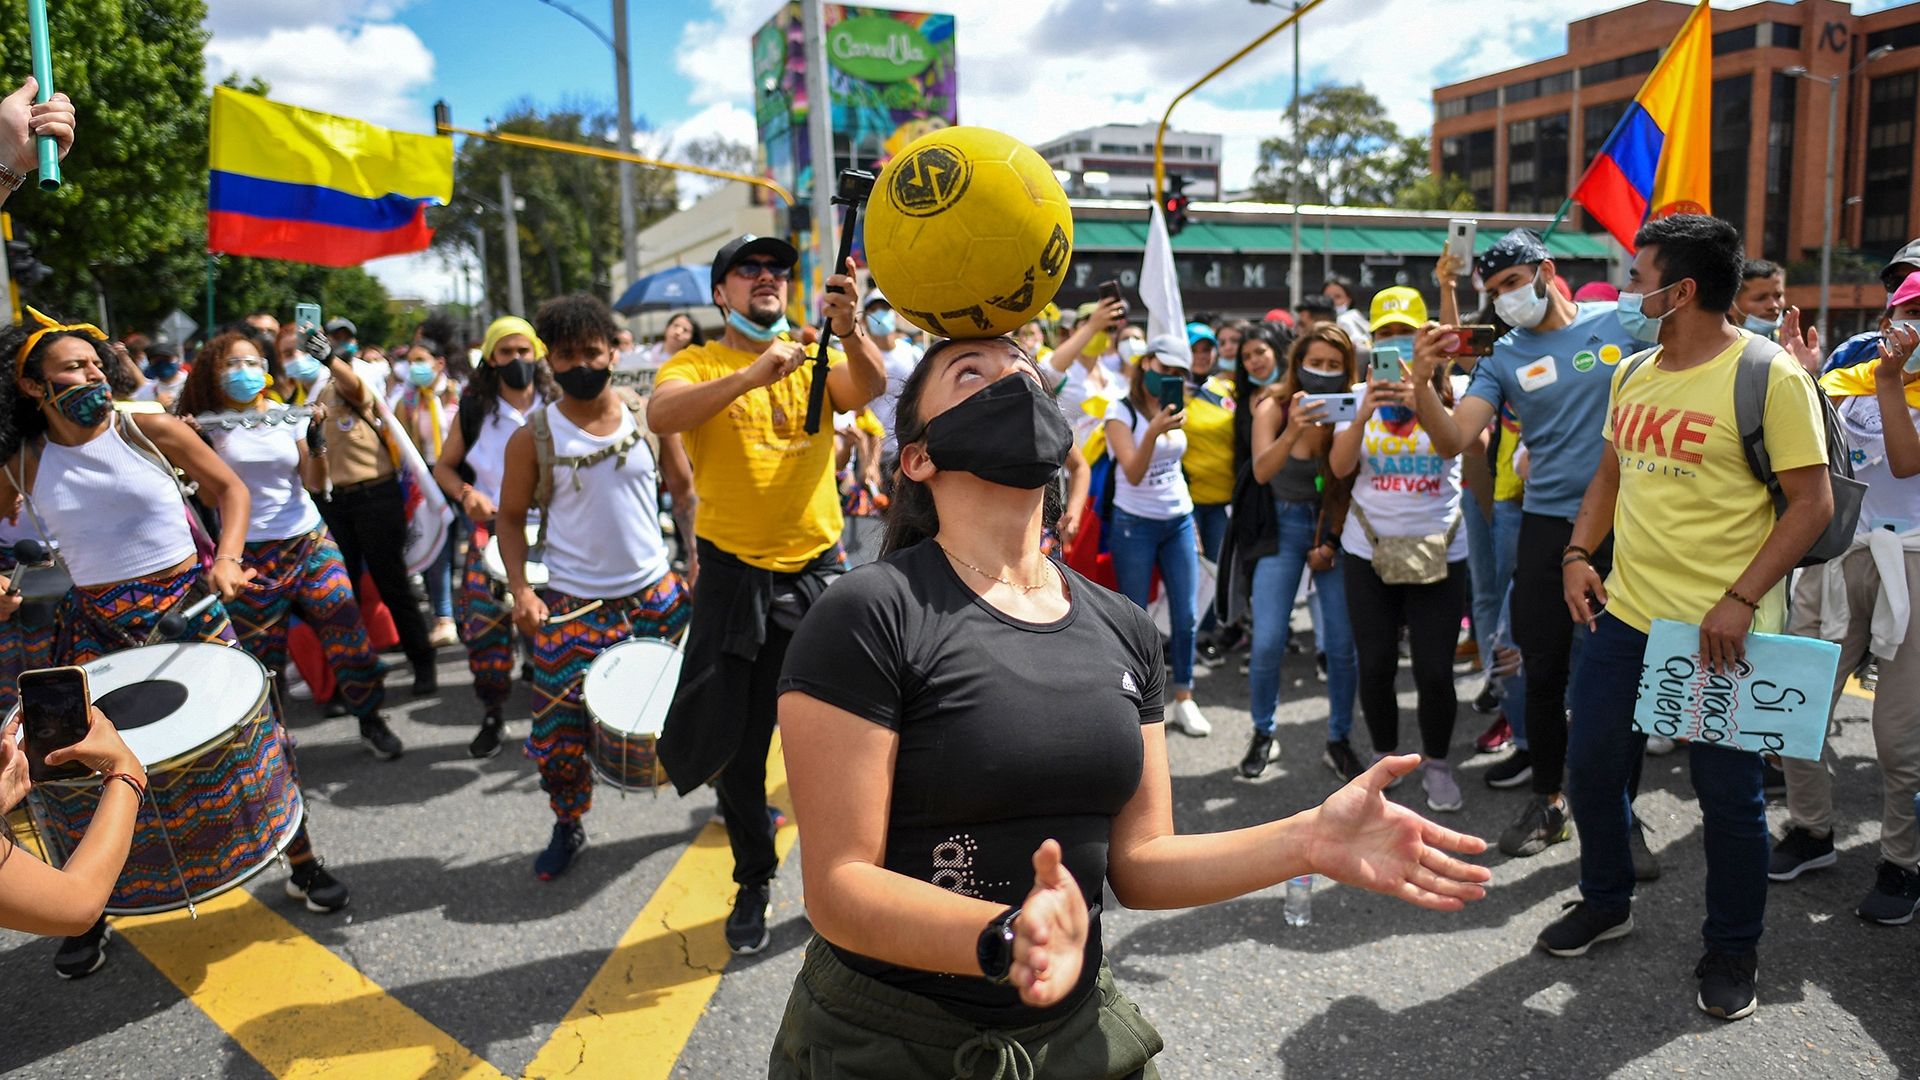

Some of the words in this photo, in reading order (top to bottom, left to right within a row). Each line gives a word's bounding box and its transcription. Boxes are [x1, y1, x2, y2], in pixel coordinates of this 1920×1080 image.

[1074, 262, 1223, 289] Fod
[1612, 402, 1717, 466] NIKE
[1653, 655, 1697, 737] Quiero
[1750, 679, 1806, 713] Si
